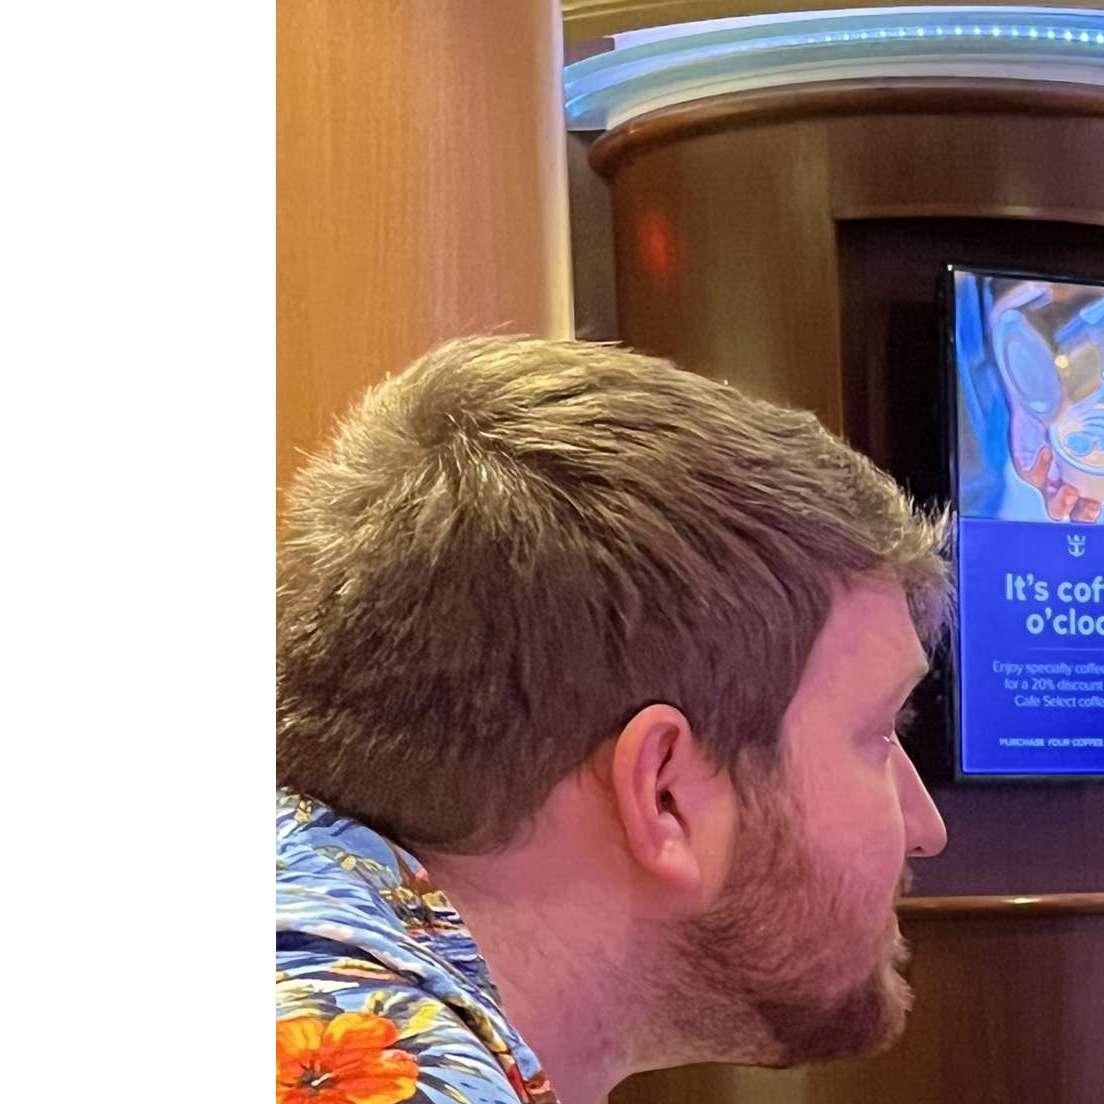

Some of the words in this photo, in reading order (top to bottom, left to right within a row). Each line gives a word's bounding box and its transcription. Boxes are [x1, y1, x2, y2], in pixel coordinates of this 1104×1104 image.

[1005, 573, 1049, 601] It's
[993, 661, 1024, 675] Enjoy
[1004, 678, 1019, 689] for
[1021, 681, 1028, 689] a
[1031, 679, 1055, 690] 20%
[1057, 680, 1103, 691] discount
[1043, 696, 1076, 707] Select
